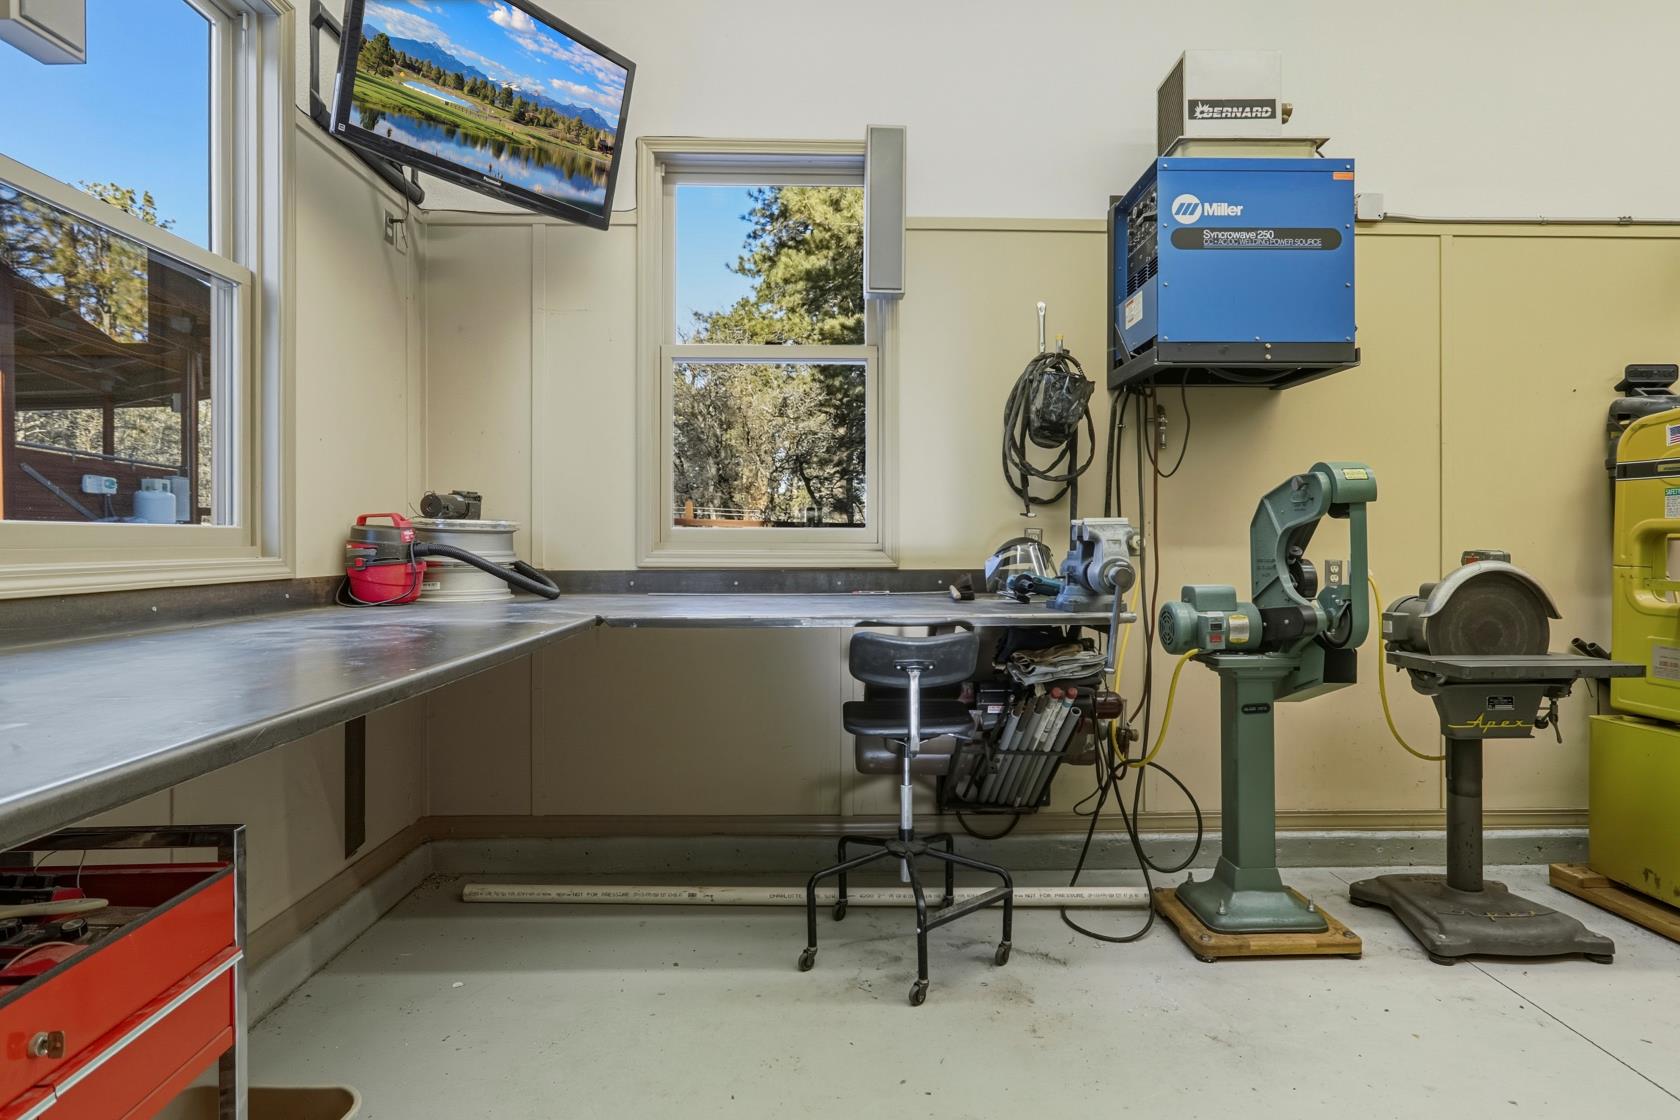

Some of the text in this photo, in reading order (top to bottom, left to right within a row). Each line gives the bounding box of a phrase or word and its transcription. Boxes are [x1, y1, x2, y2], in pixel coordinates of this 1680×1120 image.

[1202, 106, 1272, 118] BERNARD
[1203, 202, 1243, 216] Miller
[1203, 229, 1274, 239] Syncrowave 250
[1239, 238, 1269, 246] WELDING
[1270, 238, 1294, 246] POWER
[1294, 238, 1322, 246] SOURCE
[1466, 713, 1524, 734] Apex
